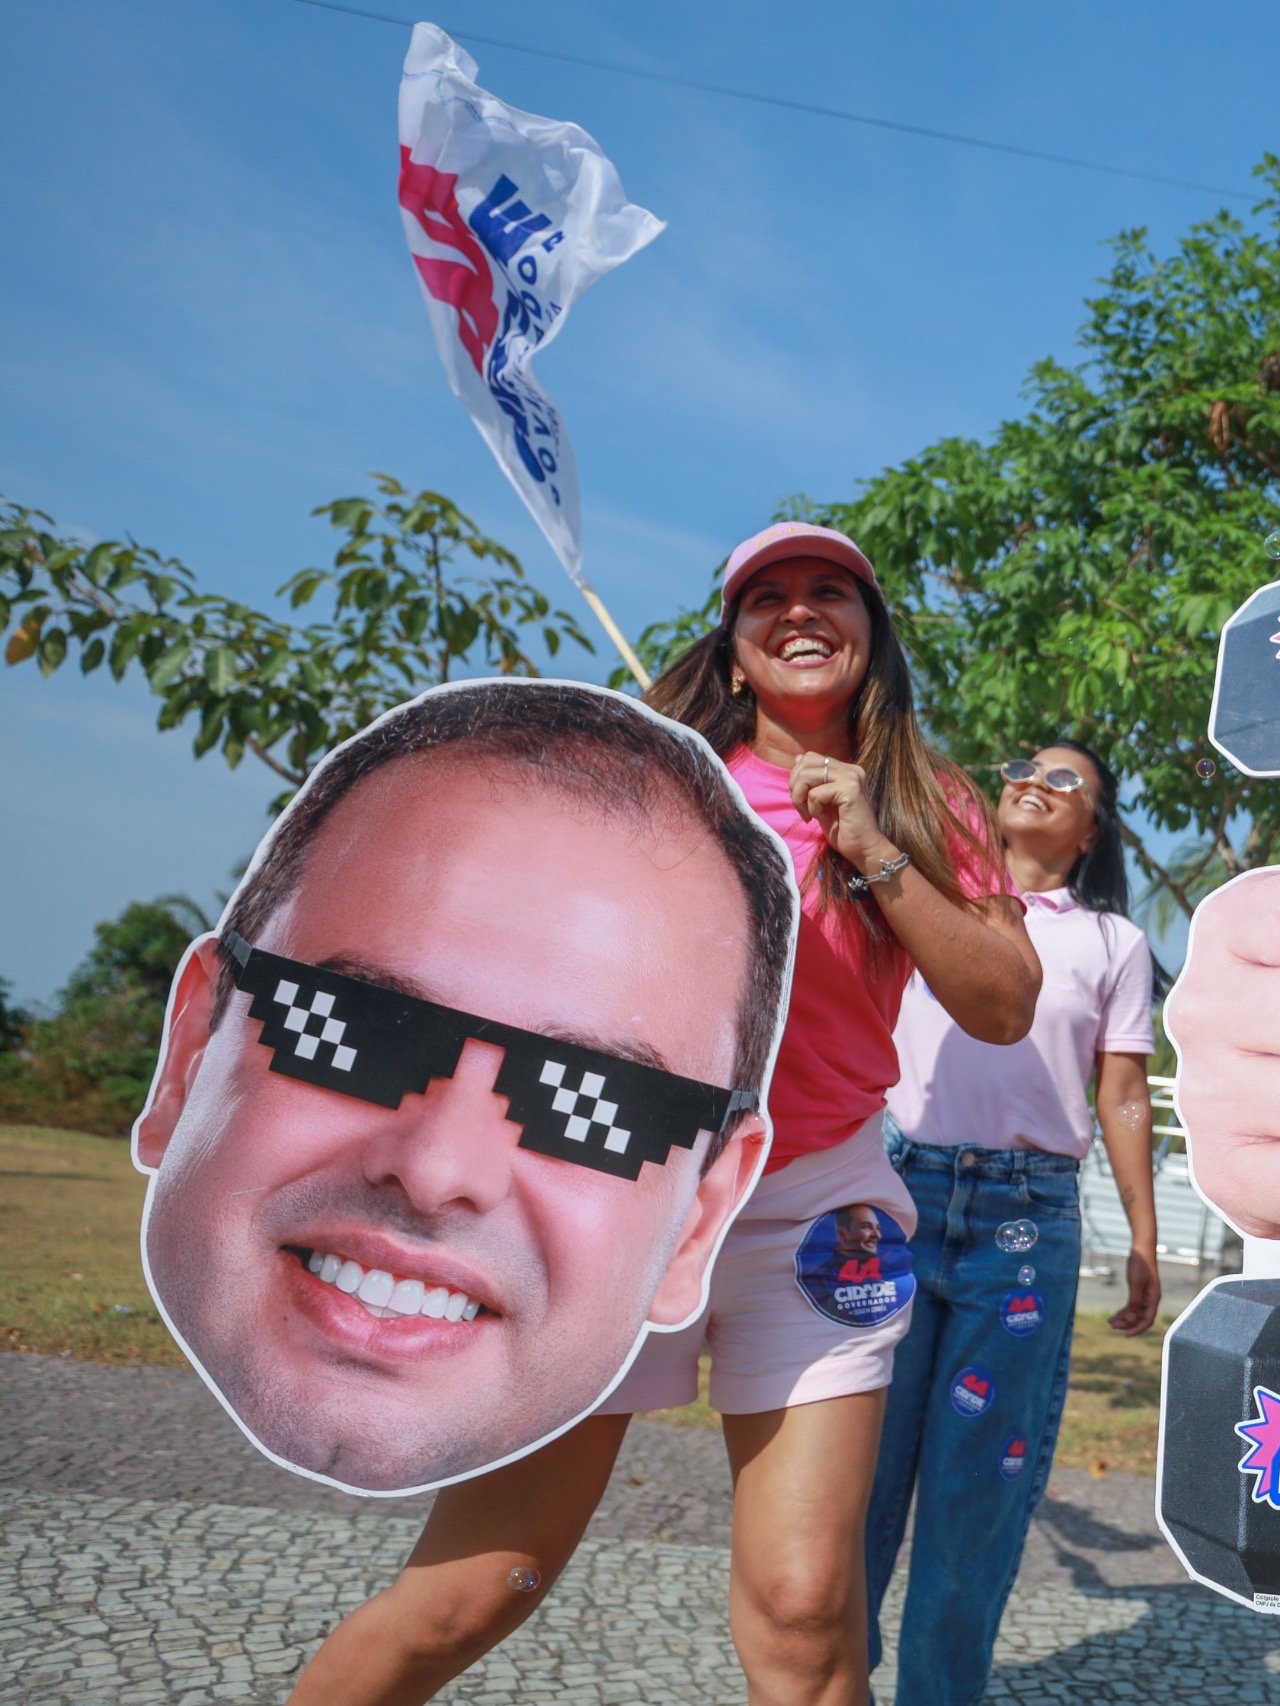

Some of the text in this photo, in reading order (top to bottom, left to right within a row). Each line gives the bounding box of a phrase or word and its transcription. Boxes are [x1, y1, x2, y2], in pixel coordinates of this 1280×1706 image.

[837, 1257, 883, 1284] 44
[834, 1280, 898, 1304] CIDADE
[1008, 1295, 1036, 1313] 44
[962, 1374, 989, 1398] 44
